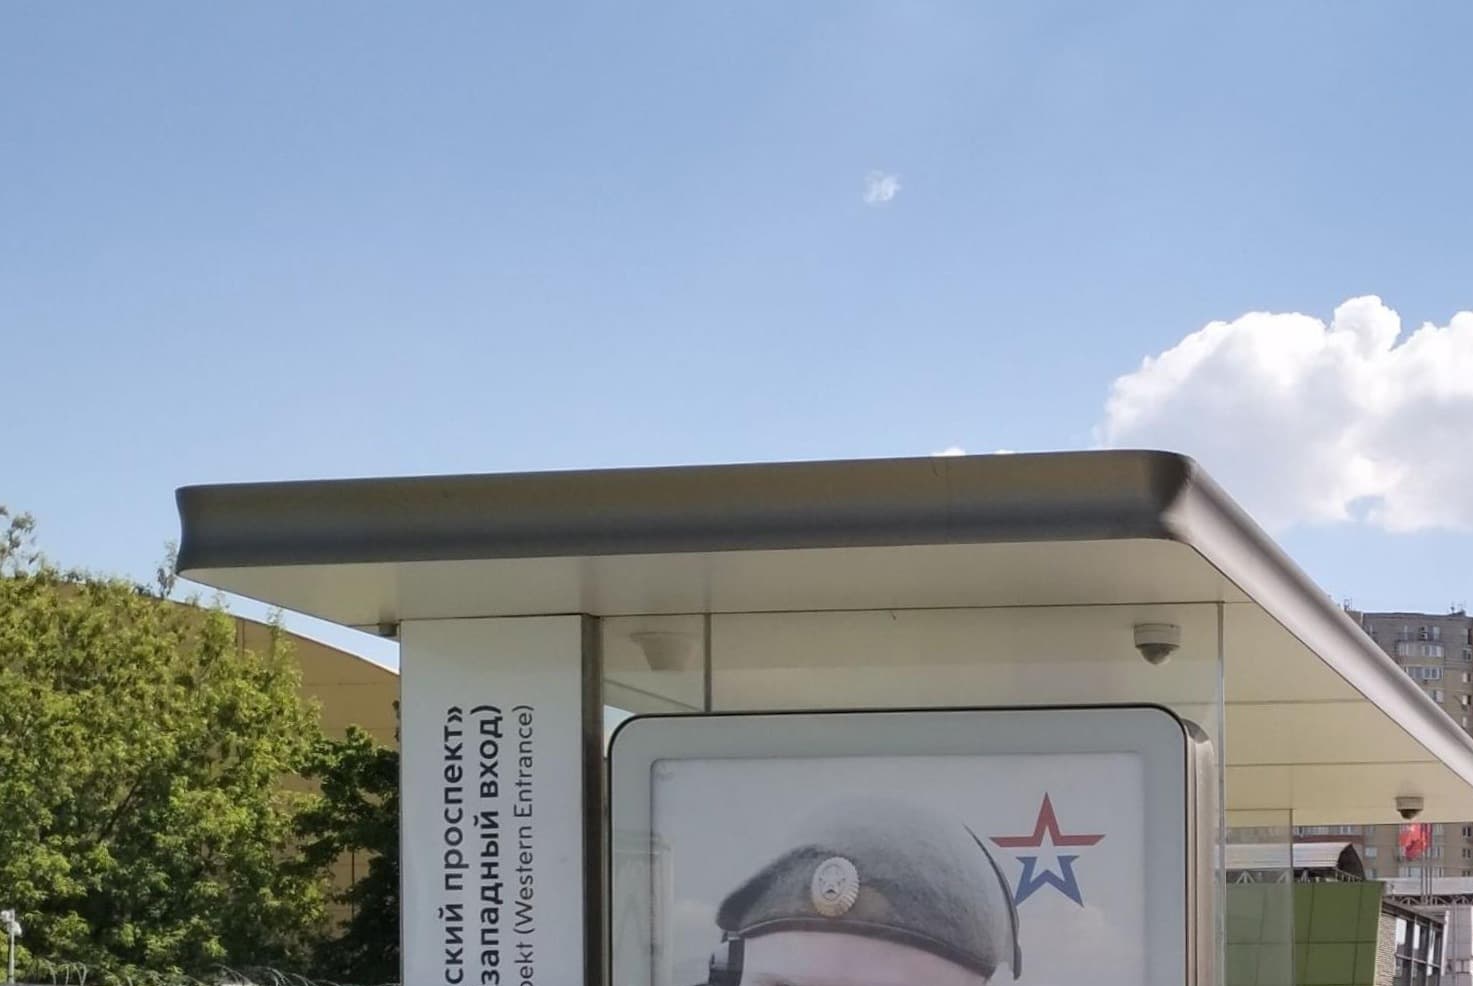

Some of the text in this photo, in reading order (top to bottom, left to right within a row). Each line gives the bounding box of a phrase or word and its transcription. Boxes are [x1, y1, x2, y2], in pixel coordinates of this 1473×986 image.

[442, 706, 469, 891] проспект»
[470, 705, 502, 799] вход)
[512, 705, 534, 817] Entrance)
[513, 825, 535, 935] (Western
